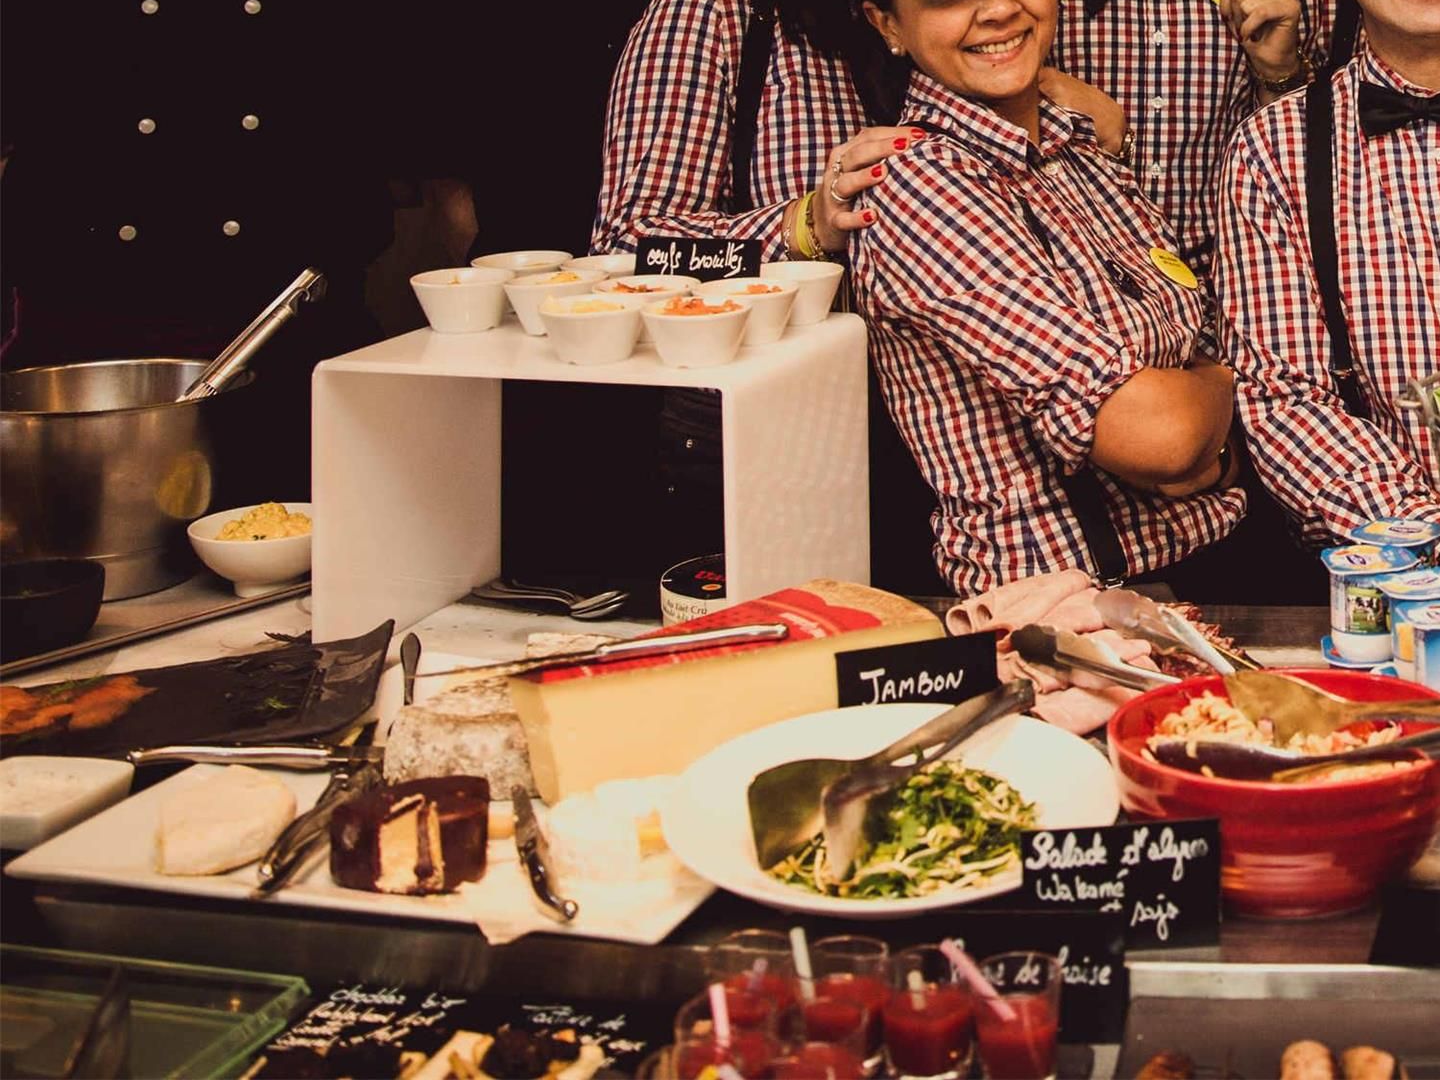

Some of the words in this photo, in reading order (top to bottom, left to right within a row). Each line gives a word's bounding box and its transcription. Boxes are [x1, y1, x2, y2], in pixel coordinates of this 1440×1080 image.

[690, 605, 708, 616] Cru
[859, 667, 965, 707] JAMBON
[1025, 831, 1108, 871] Salade
